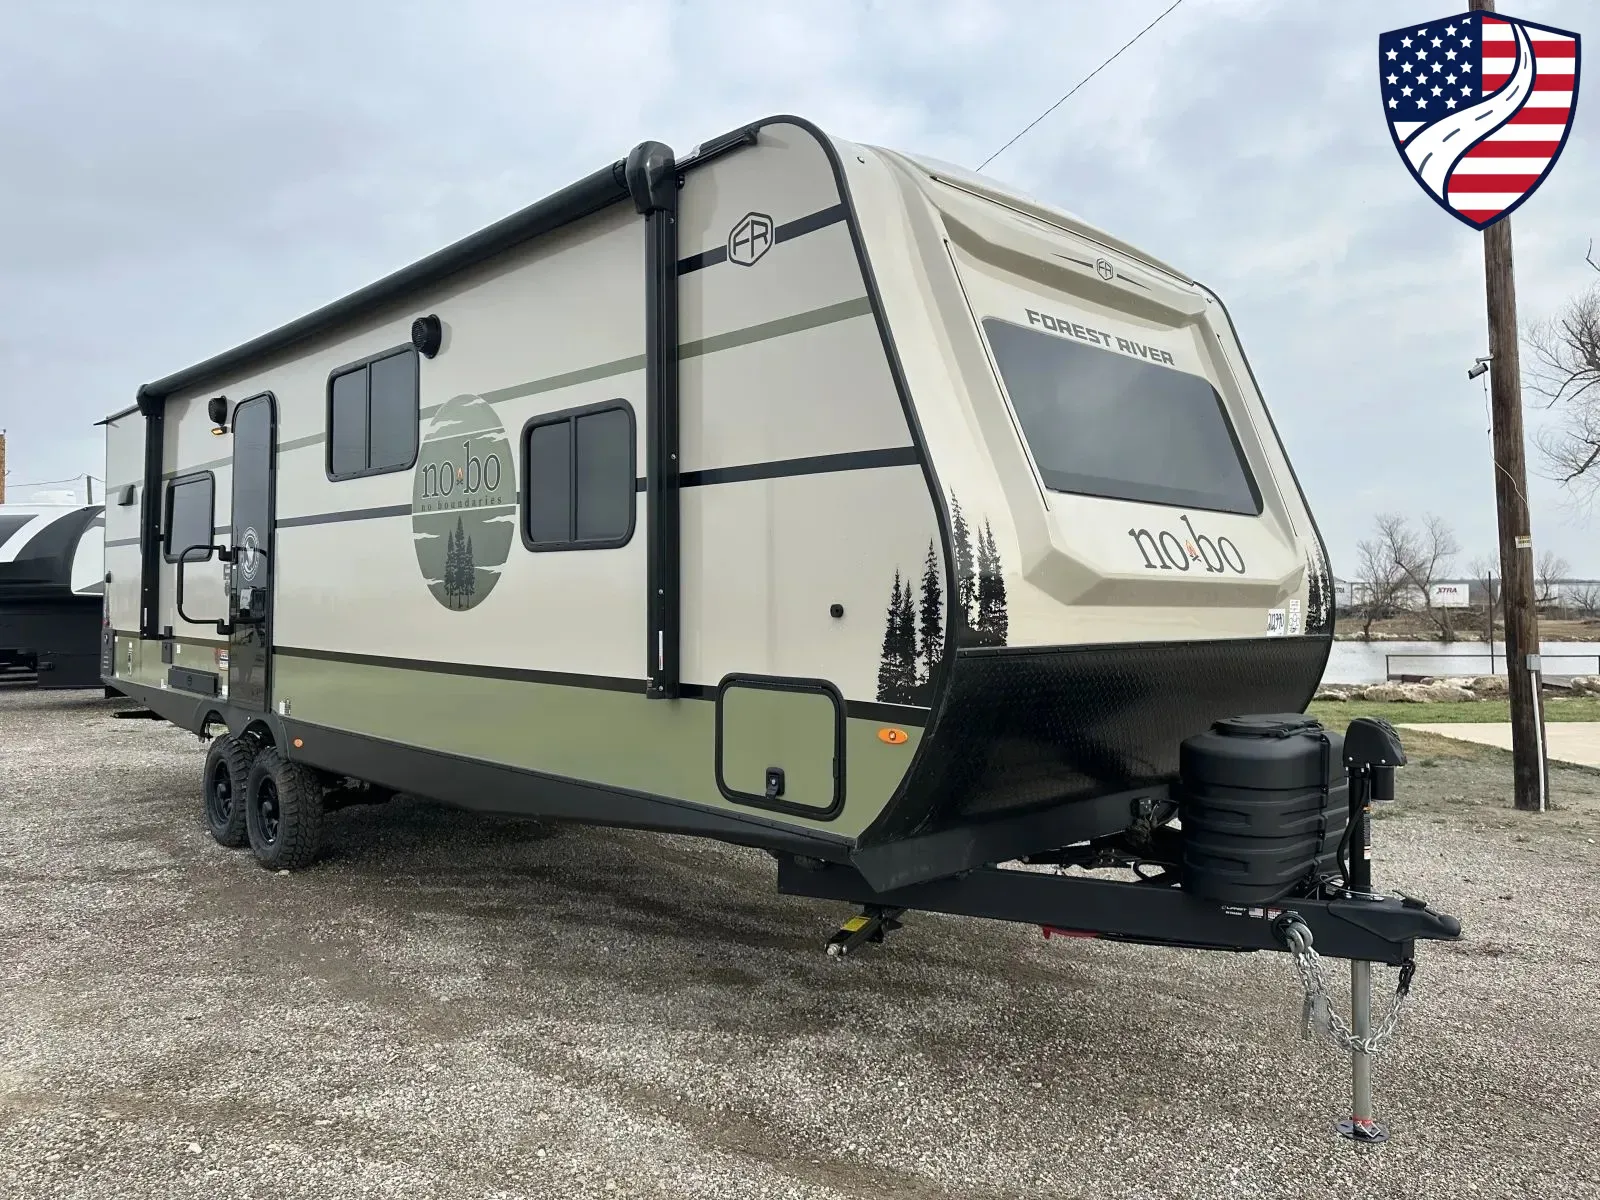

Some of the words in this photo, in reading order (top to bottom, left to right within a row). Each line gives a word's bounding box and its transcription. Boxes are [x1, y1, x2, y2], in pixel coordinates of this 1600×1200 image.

[1024, 308, 1112, 348] FOREST
[1115, 336, 1175, 366] RIVER
[421, 503, 432, 512] no
[437, 495, 502, 510] boundaries
